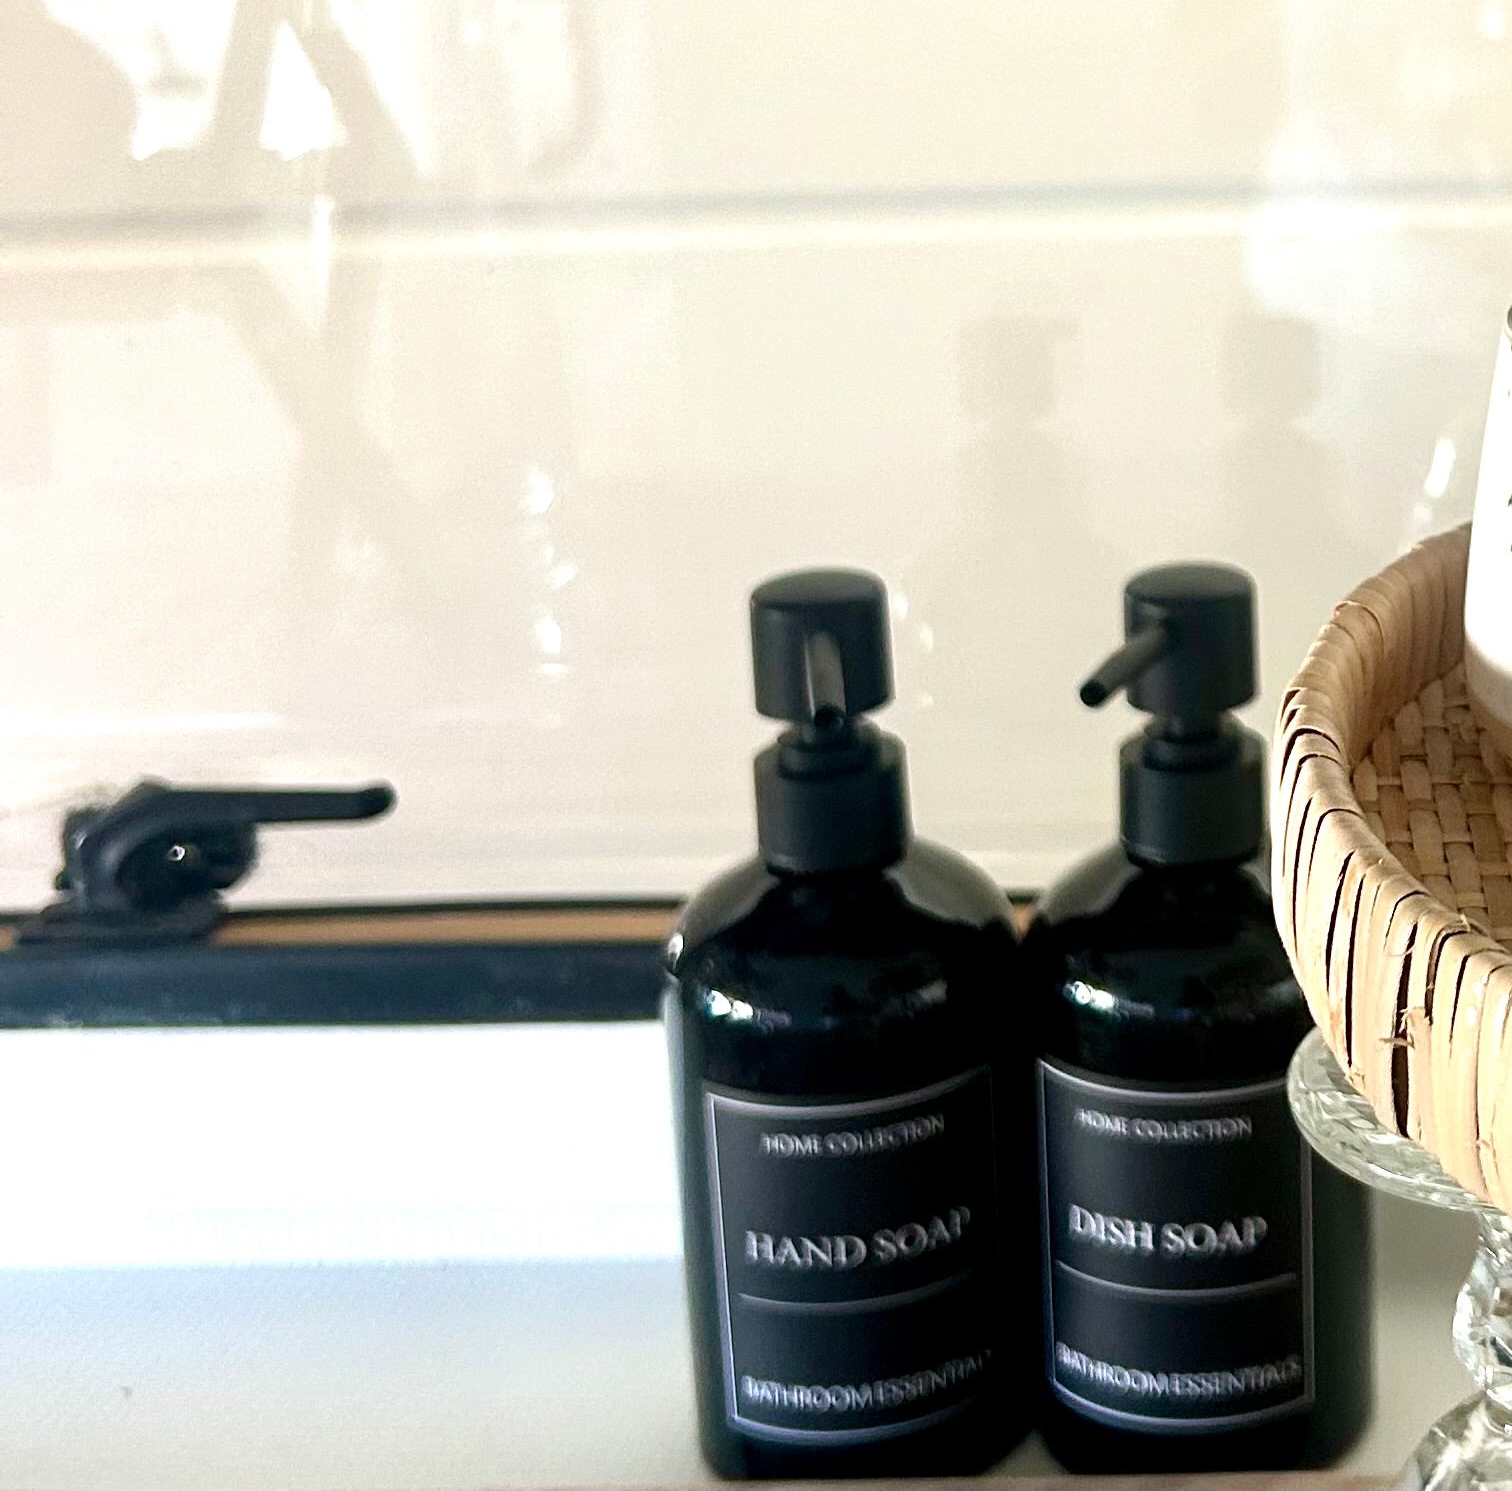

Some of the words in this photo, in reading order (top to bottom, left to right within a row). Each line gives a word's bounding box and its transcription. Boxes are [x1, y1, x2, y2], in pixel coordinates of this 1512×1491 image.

[761, 1132, 821, 1156] HOME
[823, 1113, 945, 1156] COLLECTION
[1073, 1108, 1129, 1137] HOME
[1130, 1117, 1253, 1144] COLLECTION
[744, 1229, 868, 1269] HAND
[872, 1206, 971, 1263] SOAP
[1068, 1203, 1155, 1257] DISH
[1159, 1215, 1268, 1258] SOAP
[1056, 1341, 1170, 1398] BATHROOM
